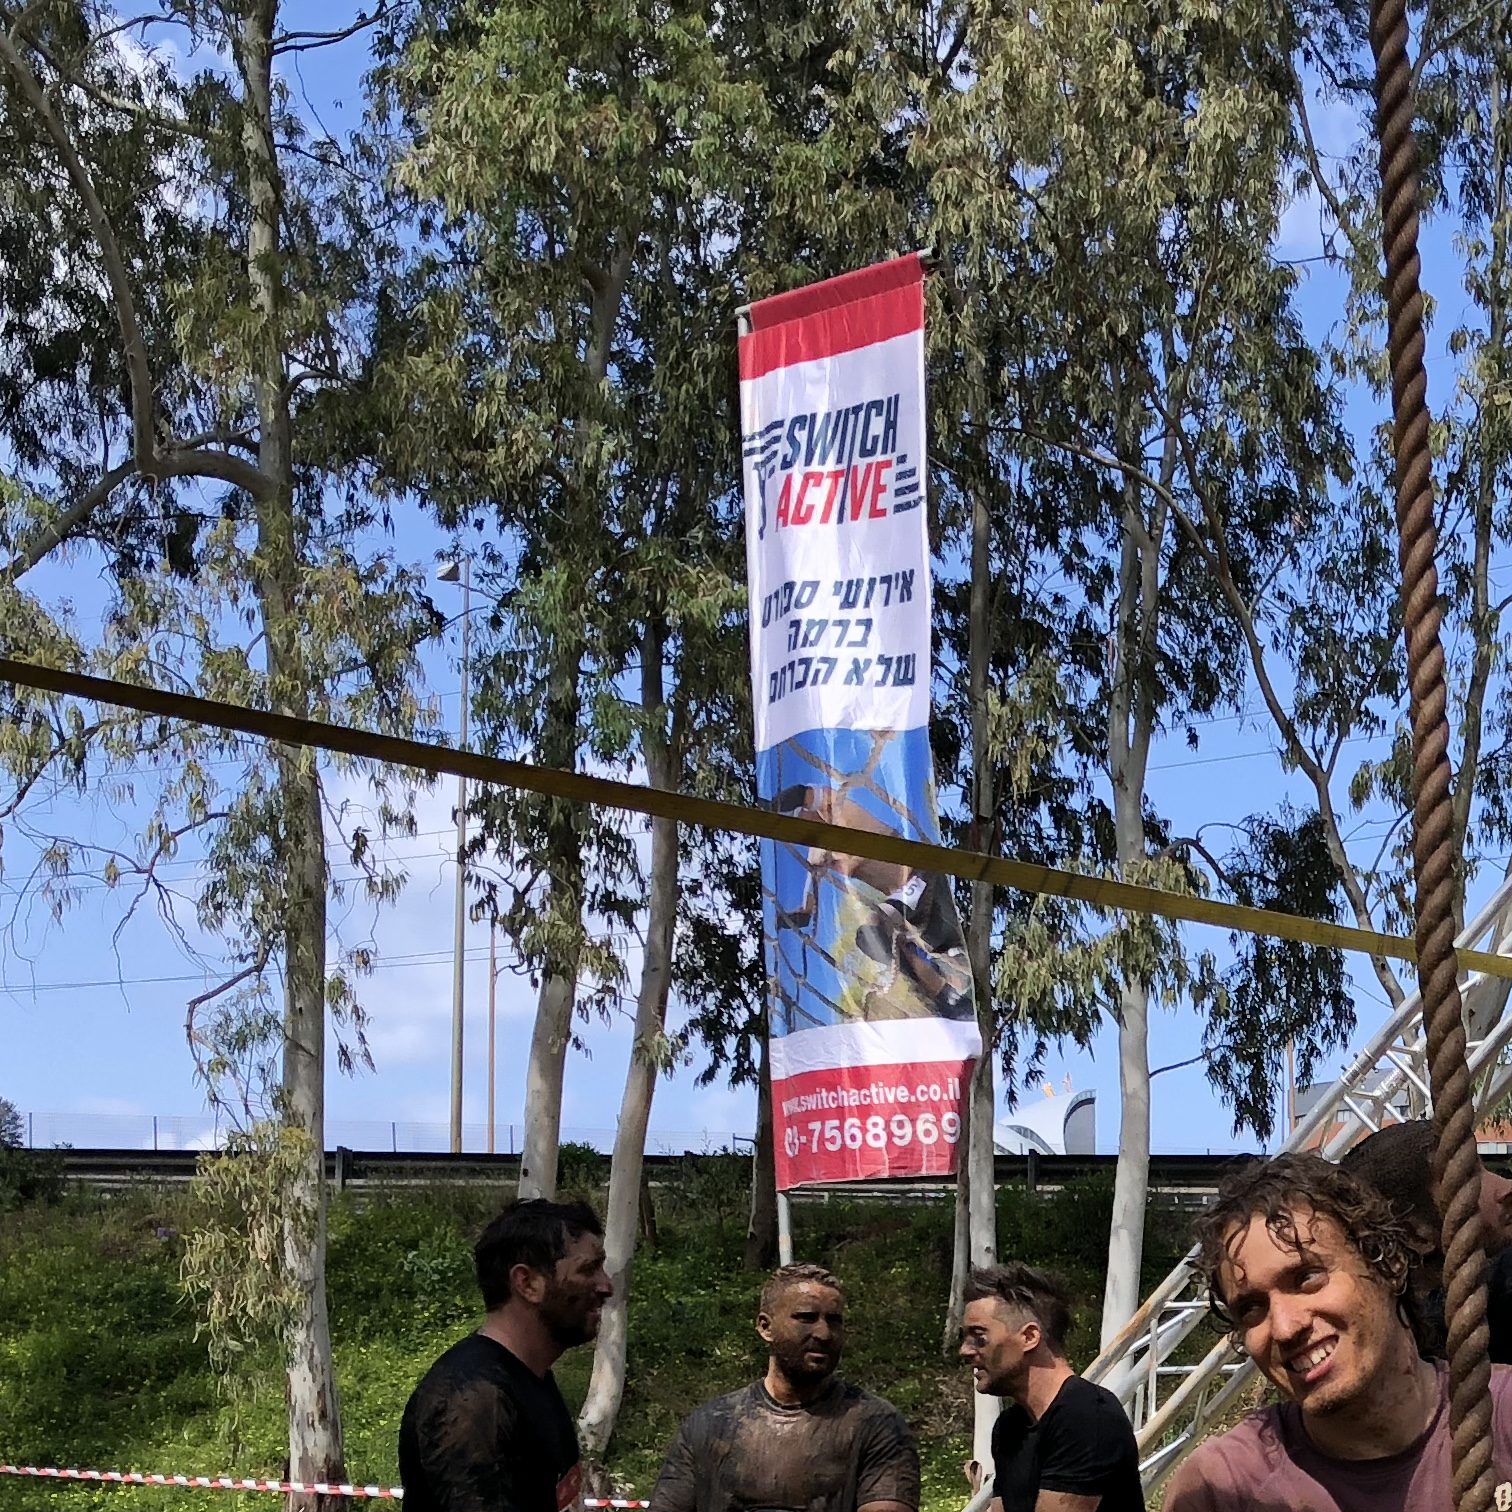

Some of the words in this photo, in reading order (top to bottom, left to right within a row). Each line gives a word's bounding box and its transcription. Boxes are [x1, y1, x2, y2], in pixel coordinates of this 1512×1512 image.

[780, 394, 900, 471] SWITCH
[776, 460, 893, 532] ACTIVE
[761, 580, 821, 629] ספורט
[832, 568, 915, 610] אירועי
[787, 618, 873, 652] ברמה
[843, 653, 916, 687] שלא
